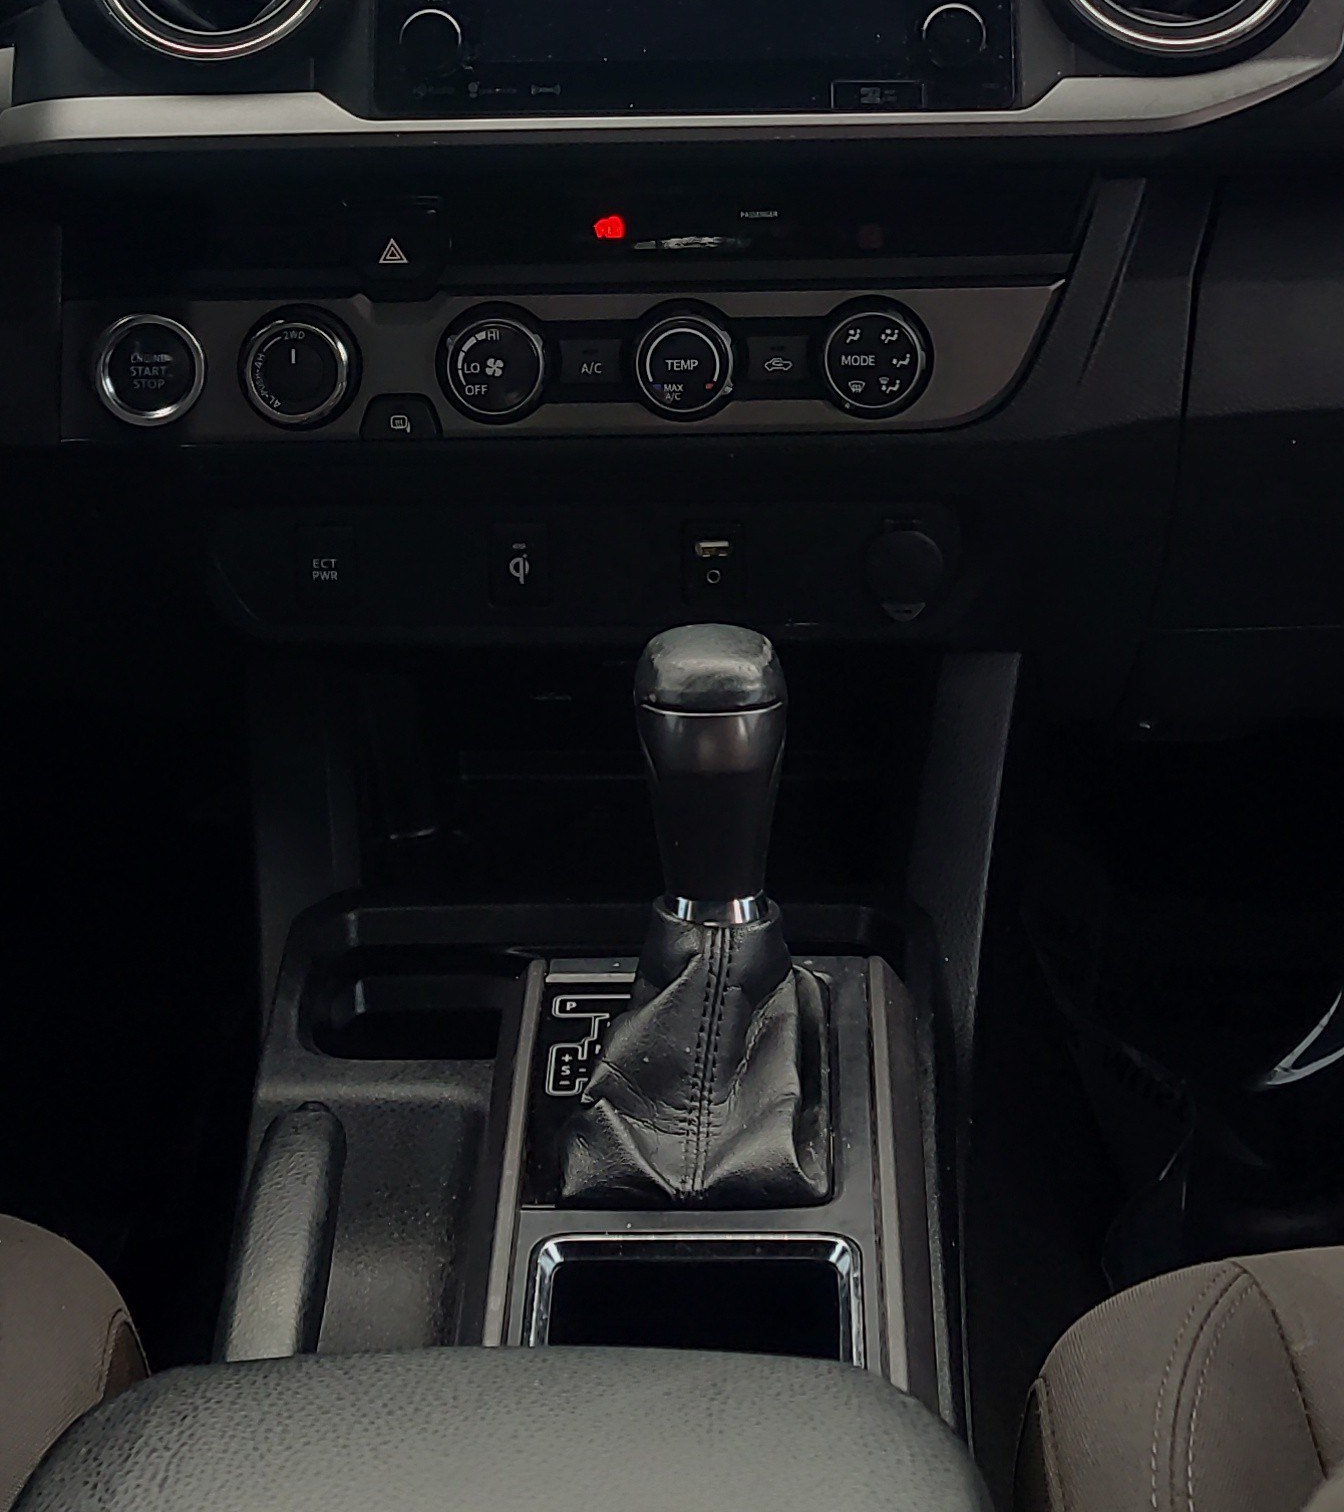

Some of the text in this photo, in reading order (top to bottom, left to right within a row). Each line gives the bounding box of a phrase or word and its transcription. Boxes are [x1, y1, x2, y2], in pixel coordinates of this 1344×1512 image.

[284, 330, 304, 340] 2WD
[487, 329, 500, 341] HI
[665, 359, 699, 371] TEMP
[840, 355, 876, 366] MODE
[129, 365, 167, 378] START
[464, 362, 480, 373] LO
[580, 362, 604, 375] A/C
[133, 377, 166, 389] STOP
[663, 383, 683, 392] MAX
[465, 384, 488, 396] OFF
[312, 558, 338, 569] ECT
[312, 570, 338, 581] PWR
[566, 1000, 578, 1012] P
[559, 1065, 572, 1076] S
